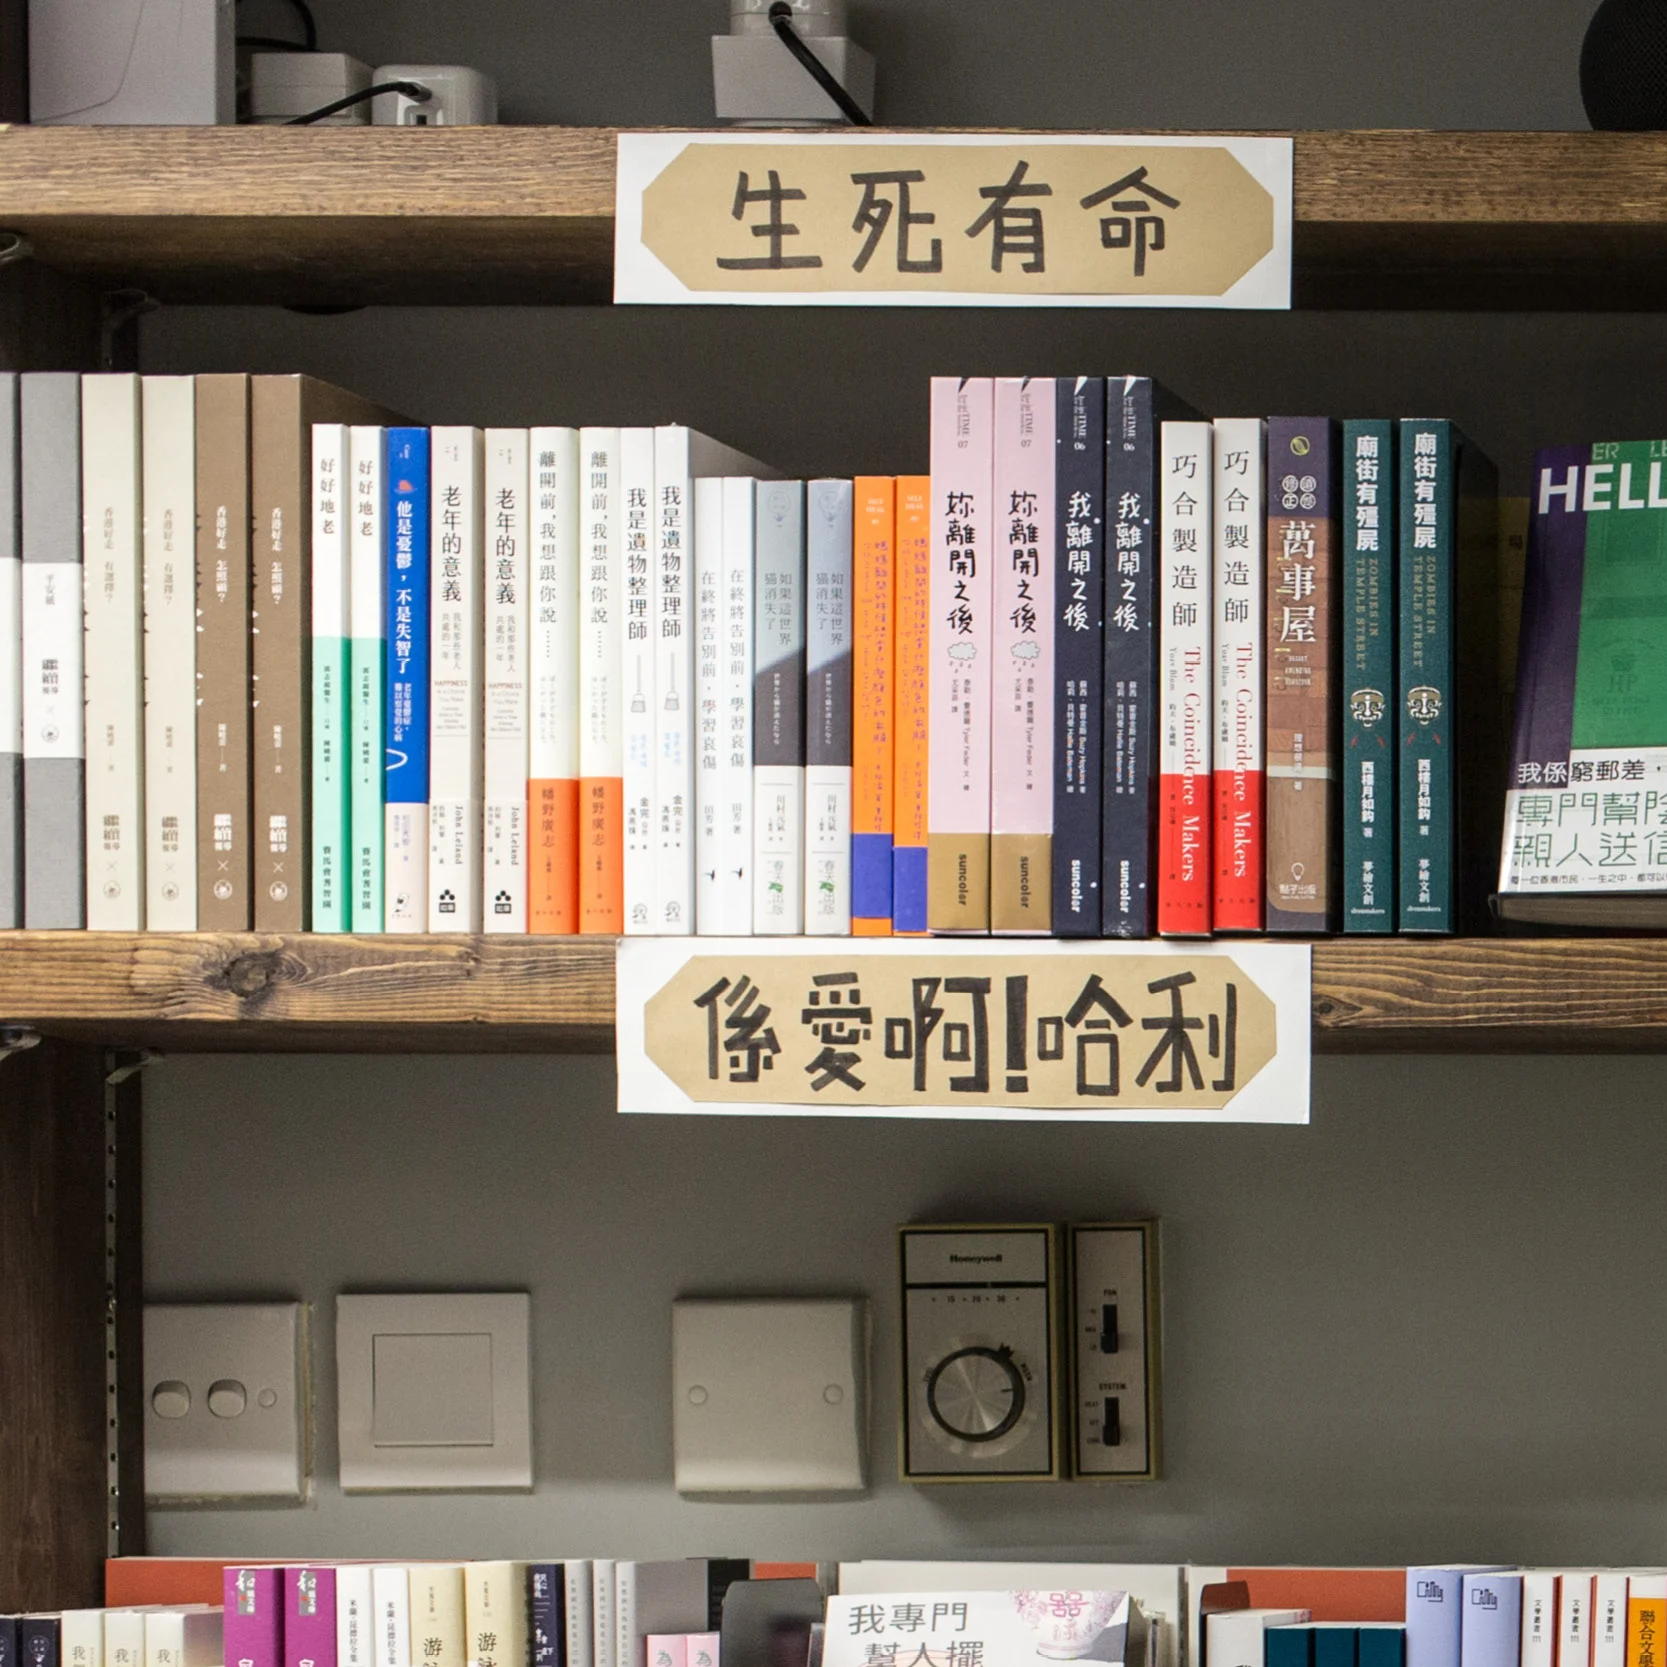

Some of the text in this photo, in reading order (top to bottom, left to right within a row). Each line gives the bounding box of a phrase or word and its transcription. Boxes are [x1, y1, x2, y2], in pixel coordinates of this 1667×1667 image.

[716, 160, 1181, 276] 生死有命
[319, 457, 336, 537] 好好地老
[441, 485, 462, 604] 老年的意義
[495, 487, 517, 606] 老年的意義
[1171, 451, 1199, 629] 巧合製造師
[1223, 449, 1249, 625] 巧合製造師
[1355, 434, 1379, 552] 廟街有殭屍
[1414, 432, 1437, 550] 廟街有殭屍
[627, 487, 648, 641] 我是遺物整理師
[660, 485, 682, 641] 我是遺物整理師
[945, 492, 975, 635] 妳離開之後
[1008, 489, 1041, 634] 妳離開之後
[1066, 493, 1094, 632] 我離開之後
[1115, 493, 1143, 632] 我離開之後
[1279, 520, 1317, 645] 萬事屋
[1233, 642, 1253, 878] The Coincidence Makers
[1070, 859, 1081, 913] suncolor
[1120, 859, 1131, 913] suncolor
[1182, 814, 1201, 882] Makers
[949, 1253, 1003, 1265] Honeywell
[849, 1602, 969, 1635] 我專門
